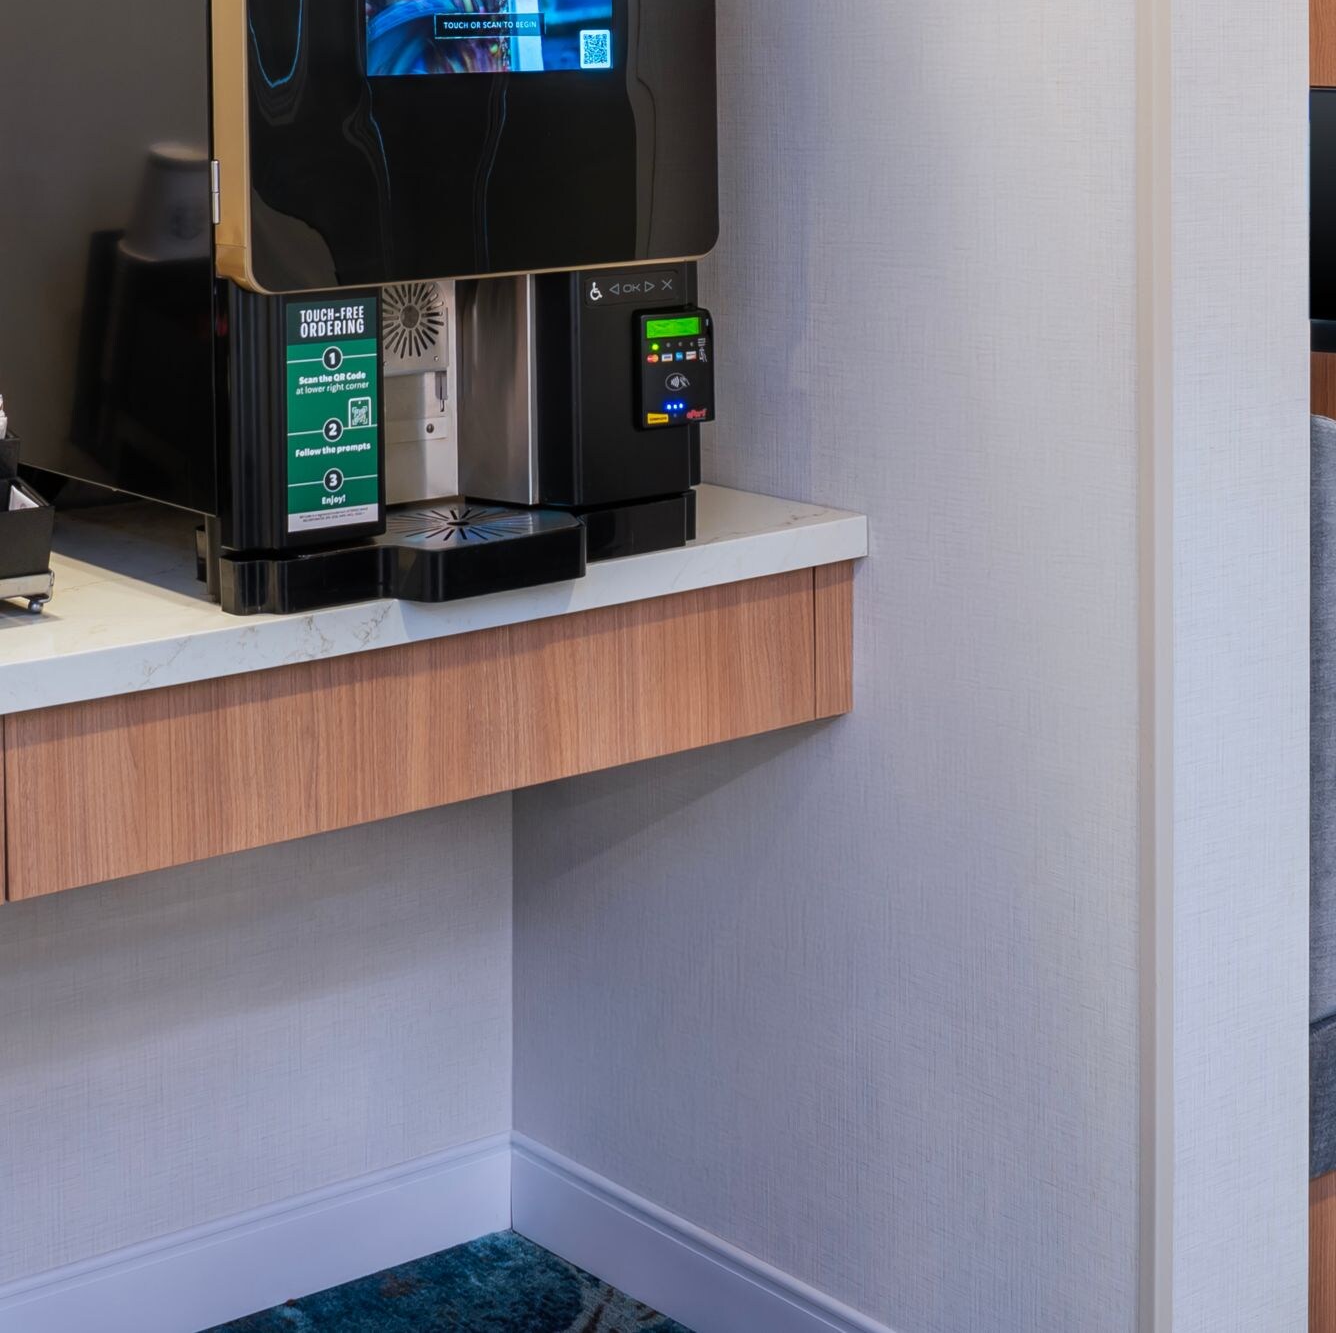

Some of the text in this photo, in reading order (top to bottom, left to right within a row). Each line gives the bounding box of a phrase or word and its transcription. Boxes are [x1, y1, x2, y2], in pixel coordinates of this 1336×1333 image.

[443, 20, 537, 29] TOUCH OR SCAN TO BEGIN
[622, 283, 641, 294] OK
[300, 305, 364, 323] TOUCH-FREE
[300, 319, 365, 338] ORDERING
[329, 351, 336, 365] 1
[299, 371, 366, 385] Scan the QR Code
[296, 381, 369, 395] at lower right corner
[329, 423, 338, 436] 2
[295, 443, 371, 458] Follow the prompts
[329, 473, 338, 487] 3
[321, 494, 346, 505] Enjoy!
